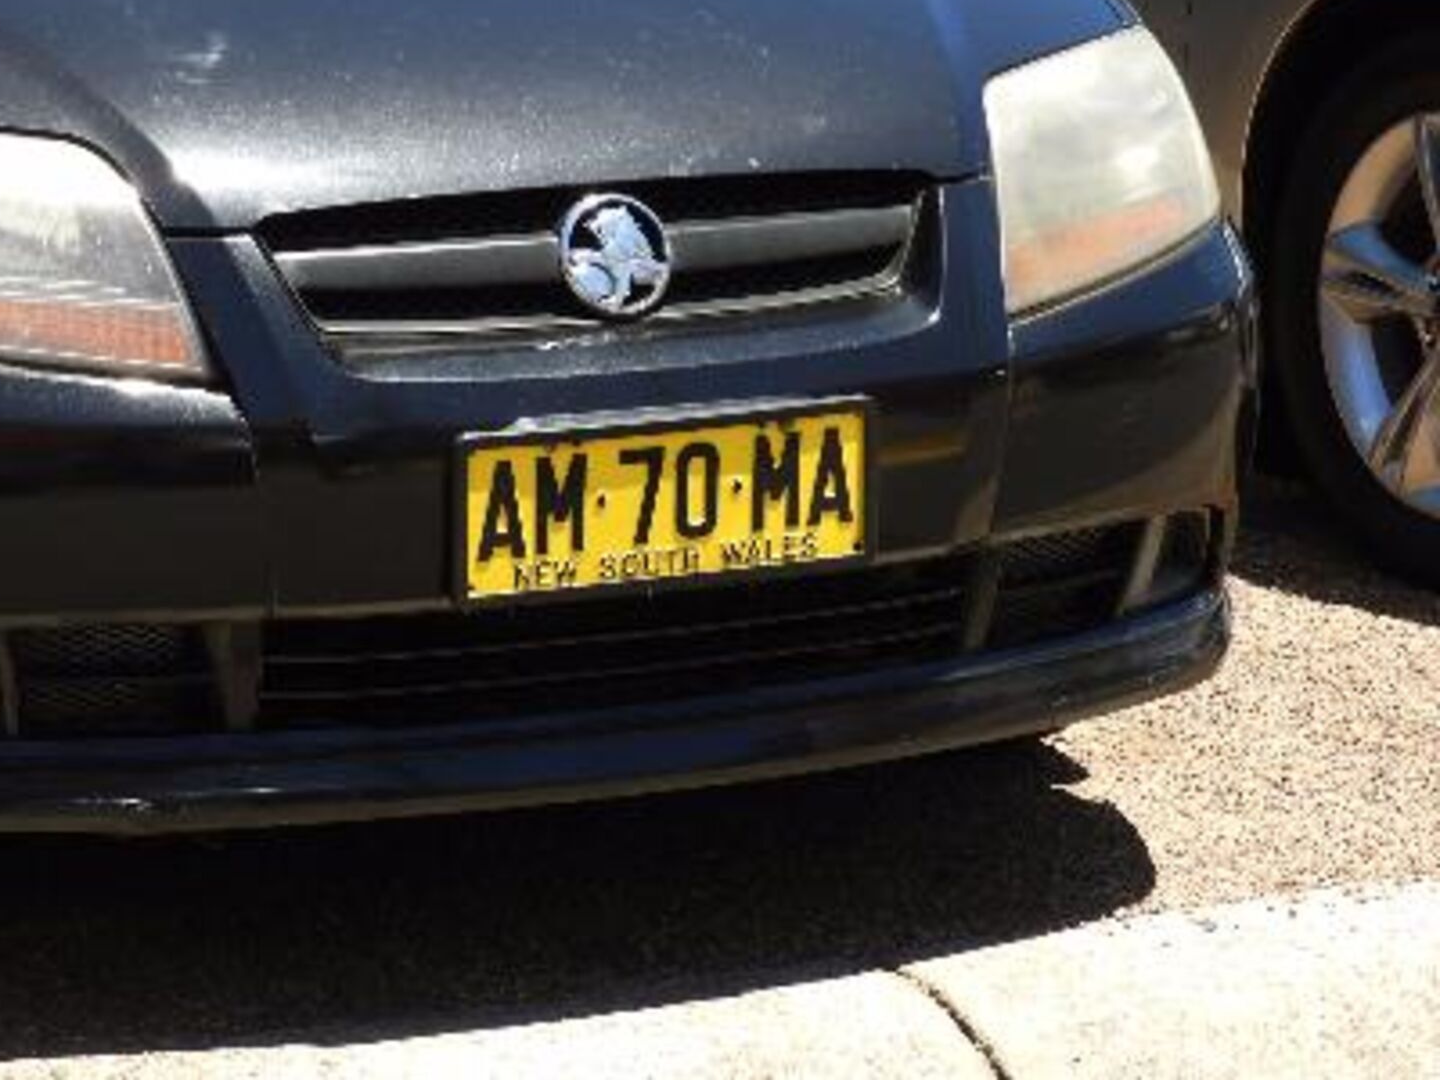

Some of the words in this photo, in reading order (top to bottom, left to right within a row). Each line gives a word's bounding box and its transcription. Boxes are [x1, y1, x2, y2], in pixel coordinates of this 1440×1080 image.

[514, 560, 576, 588] NEW
[598, 548, 699, 578] SOUTH
[720, 533, 818, 565] WALES
